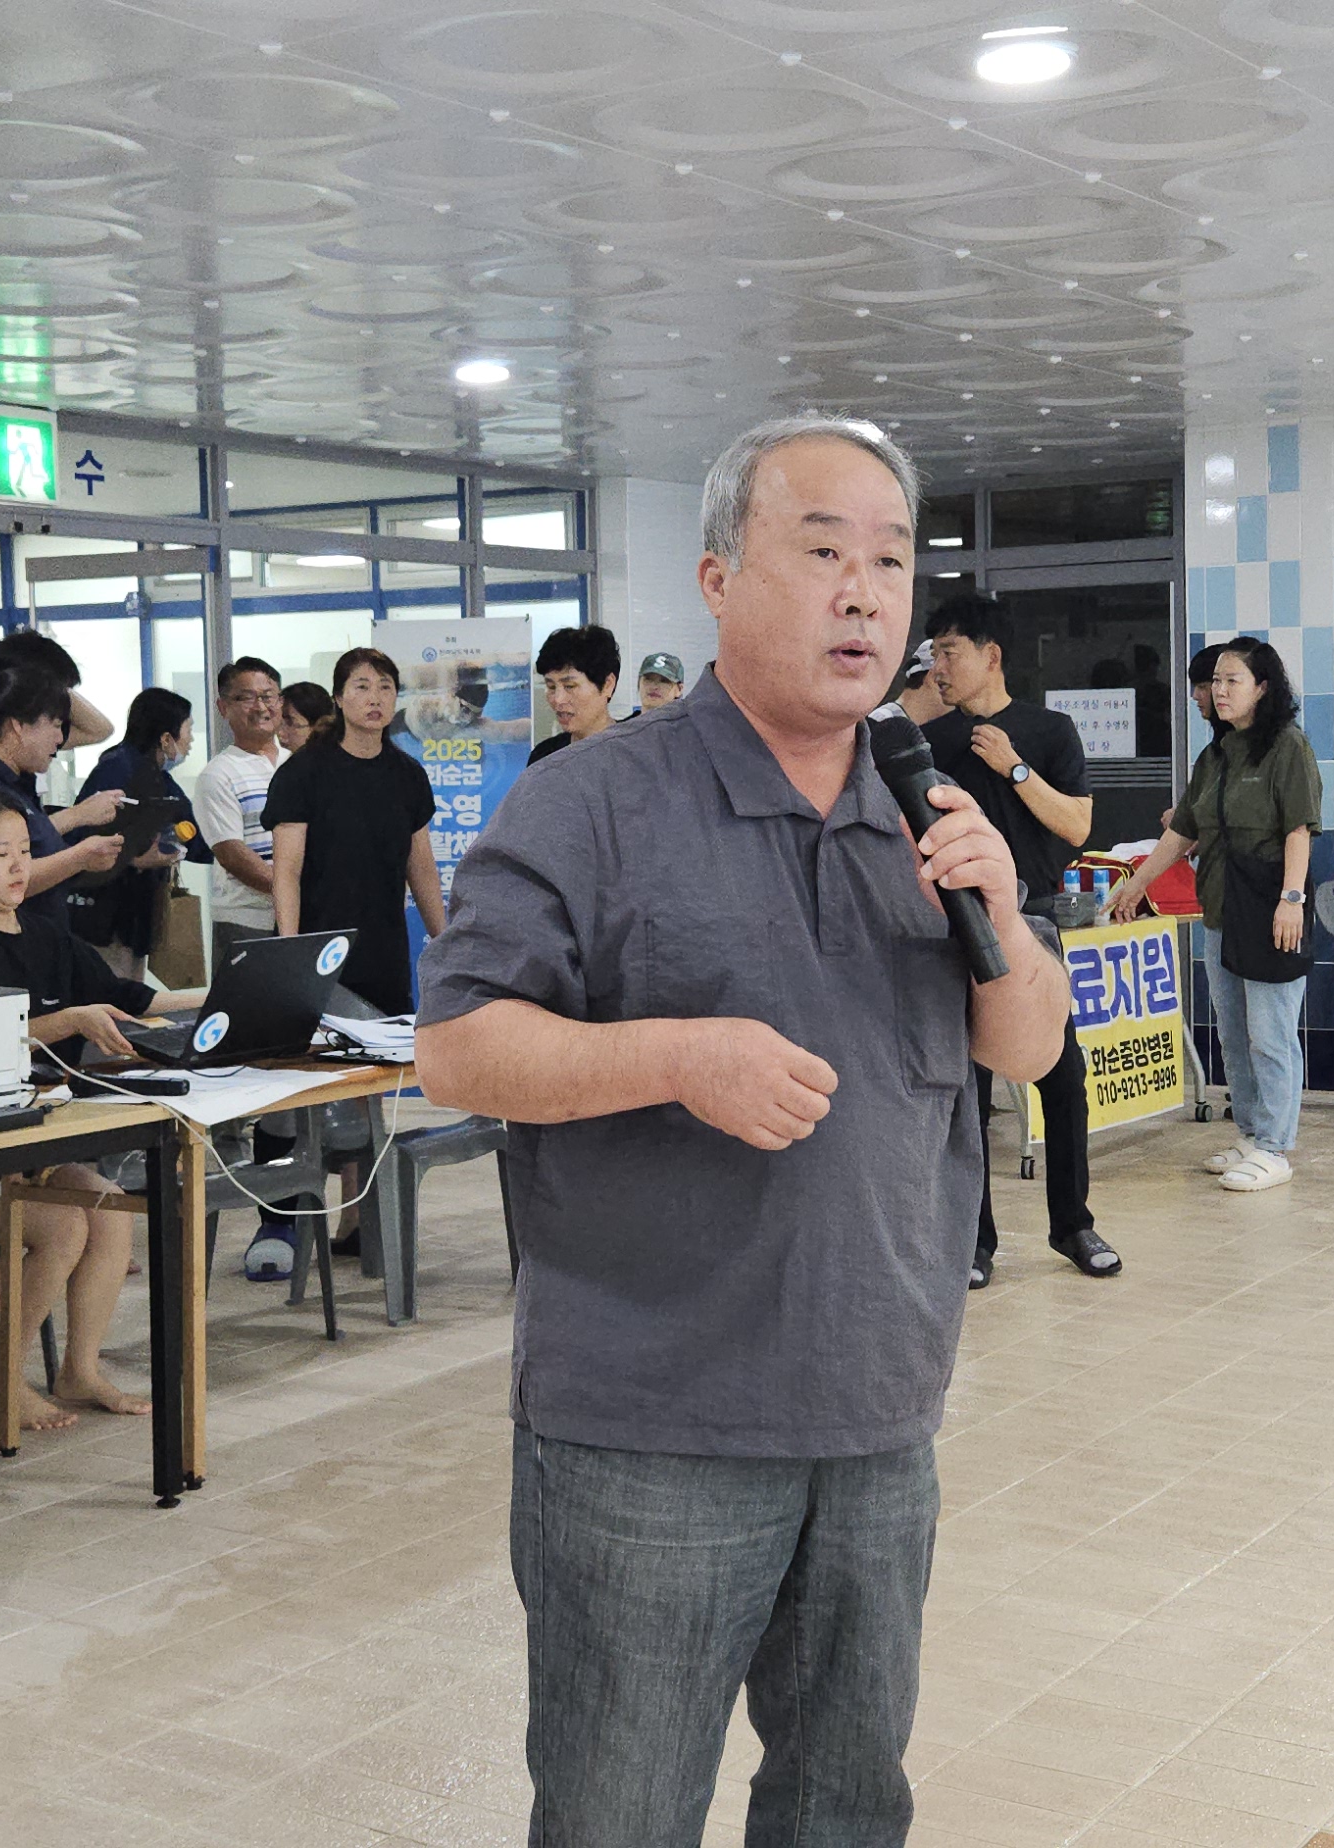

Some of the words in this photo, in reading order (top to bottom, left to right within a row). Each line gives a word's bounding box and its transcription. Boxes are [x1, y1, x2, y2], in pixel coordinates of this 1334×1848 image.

[422, 738, 482, 761] 2025
[424, 764, 482, 786] 화순군
[433, 795, 482, 826] 수영
[1067, 932, 1179, 1028] 료지원
[1091, 1030, 1175, 1078] 화순중앙병원
